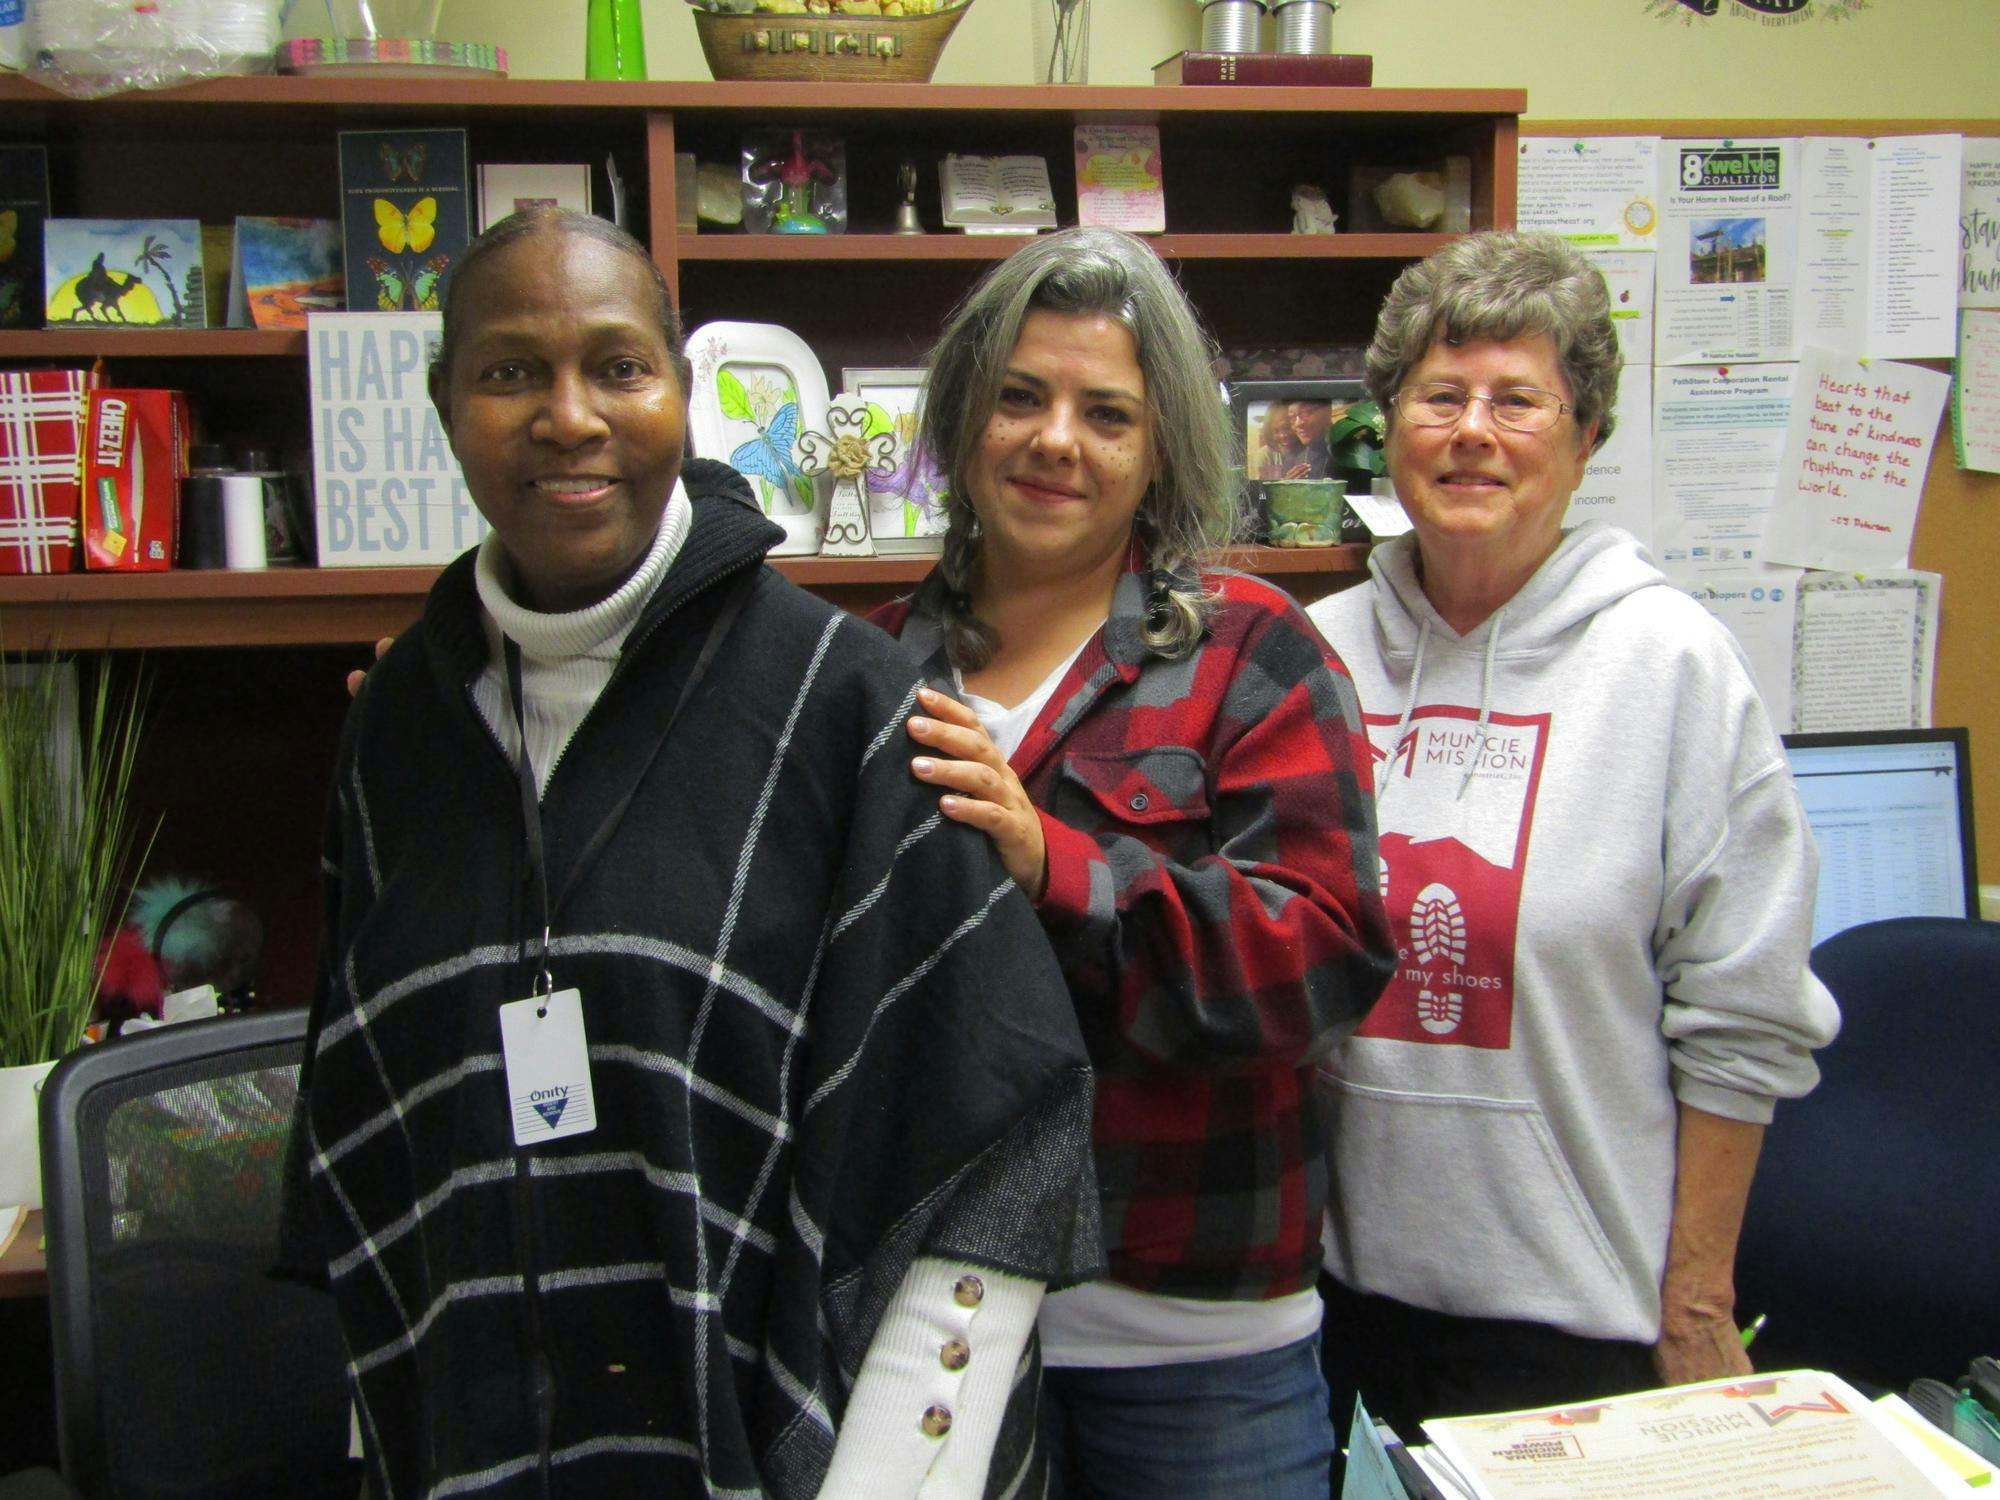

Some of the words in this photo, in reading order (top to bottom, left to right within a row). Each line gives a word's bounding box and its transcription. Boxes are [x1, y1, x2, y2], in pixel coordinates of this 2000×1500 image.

[1703, 174, 1776, 186] COALITION
[1678, 195, 1694, 204] Your
[1696, 194, 1718, 203] Home
[1720, 194, 1727, 203] in
[1729, 194, 1750, 203] Need
[1751, 193, 1760, 202] of
[1672, 377, 1710, 386] PathStone
[1762, 375, 1789, 384] Rental
[1819, 373, 1867, 398] Hearts
[1874, 386, 1911, 403] that
[1689, 388, 1732, 397] Assistance
[1734, 387, 1769, 396] Program
[1815, 394, 1841, 412] beat
[1848, 403, 1862, 417] to
[1867, 406, 1893, 422] the
[323, 407, 367, 473] IS
[383, 407, 462, 471] HA
[1809, 415, 1837, 433] tune
[1847, 422, 1864, 437] of
[1867, 425, 1923, 448] kindness
[1806, 438, 1829, 453] can
[1835, 441, 1880, 465] change
[1886, 450, 1911, 467] the
[1584, 464, 1622, 476] dence
[1802, 456, 1854, 478] rhythm
[1860, 466, 1877, 480] of
[1883, 470, 1908, 487] the
[1797, 479, 1848, 498] world.
[1574, 494, 1617, 506] income
[326, 477, 436, 552] BEST
[1691, 590, 1707, 600] Get
[1428, 731, 1521, 754] MUNCIE
[1425, 748, 1527, 770] MISION
[1405, 968, 1434, 988] my
[1442, 964, 1503, 989] shoes
[530, 1085, 570, 1102] Onity
[1640, 1410, 1745, 1436] MISSION
[1654, 1418, 1753, 1444] MUNCIE
[1491, 1446, 1565, 1456] MICHIGAN
